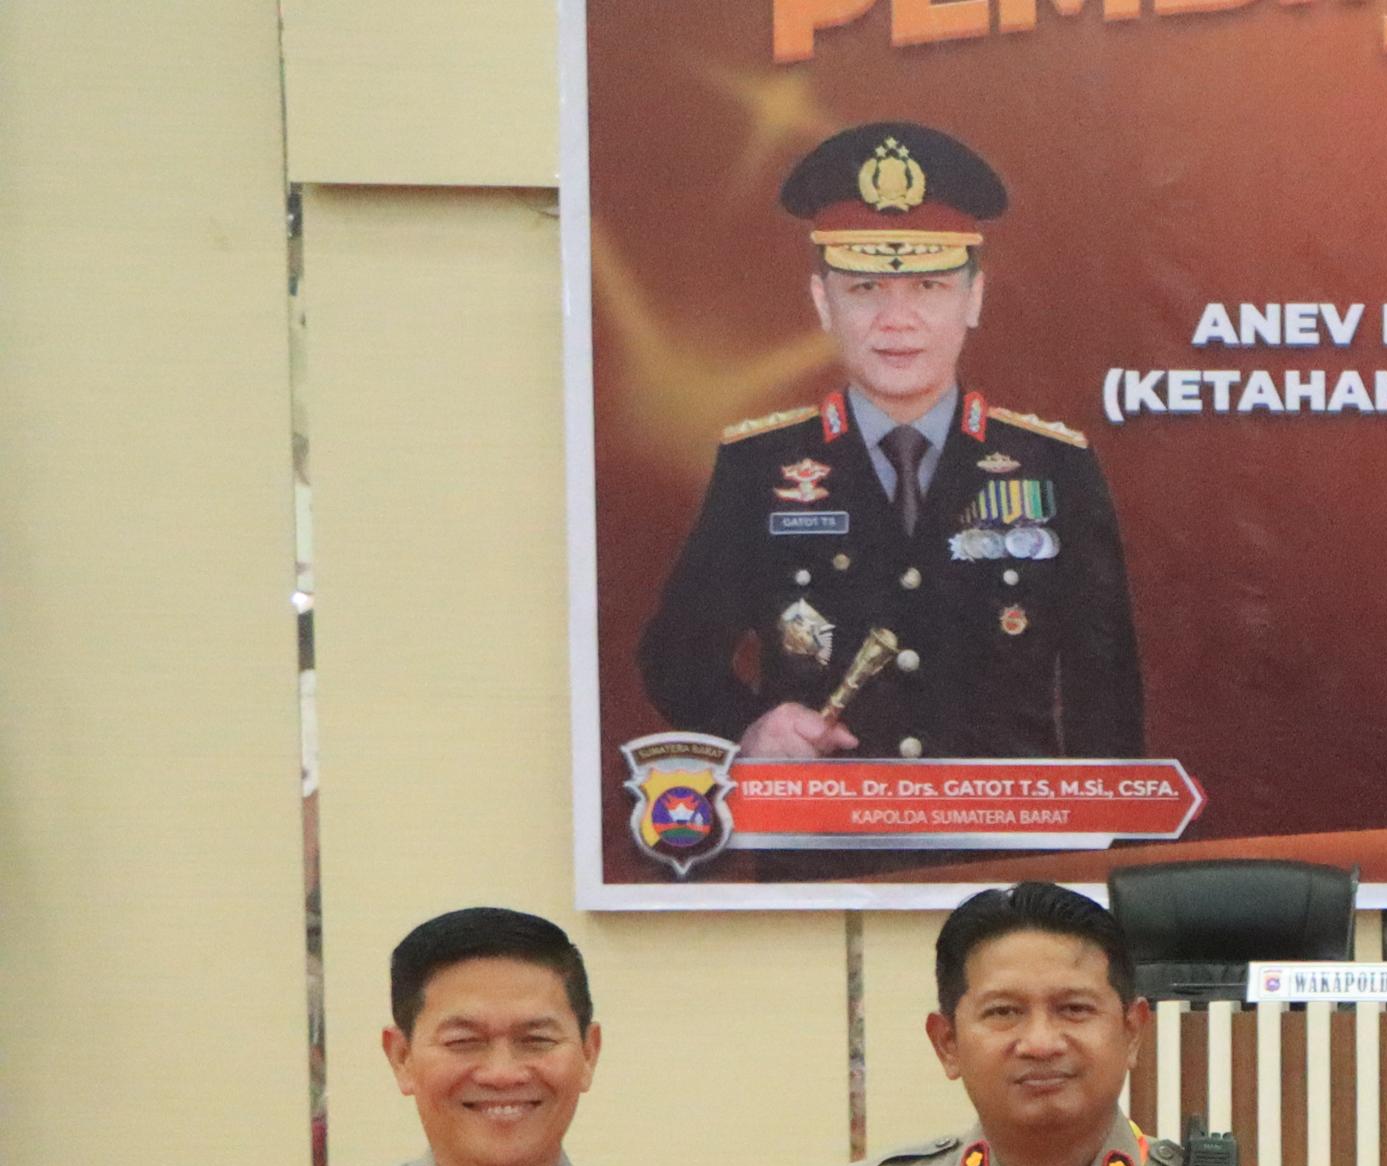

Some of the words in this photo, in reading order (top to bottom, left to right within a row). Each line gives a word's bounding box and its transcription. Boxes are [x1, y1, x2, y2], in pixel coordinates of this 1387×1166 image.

[1192, 302, 1364, 349] ANEV
[742, 779, 801, 797] IRJEN
[808, 780, 856, 797] POL.
[862, 780, 894, 797] Dr.
[898, 780, 938, 797] Drs.
[943, 780, 1014, 797] GATOT
[851, 809, 927, 825] KAPOLDA
[931, 809, 1017, 825] SUMATERA
[1020, 809, 1071, 825] BARAT
